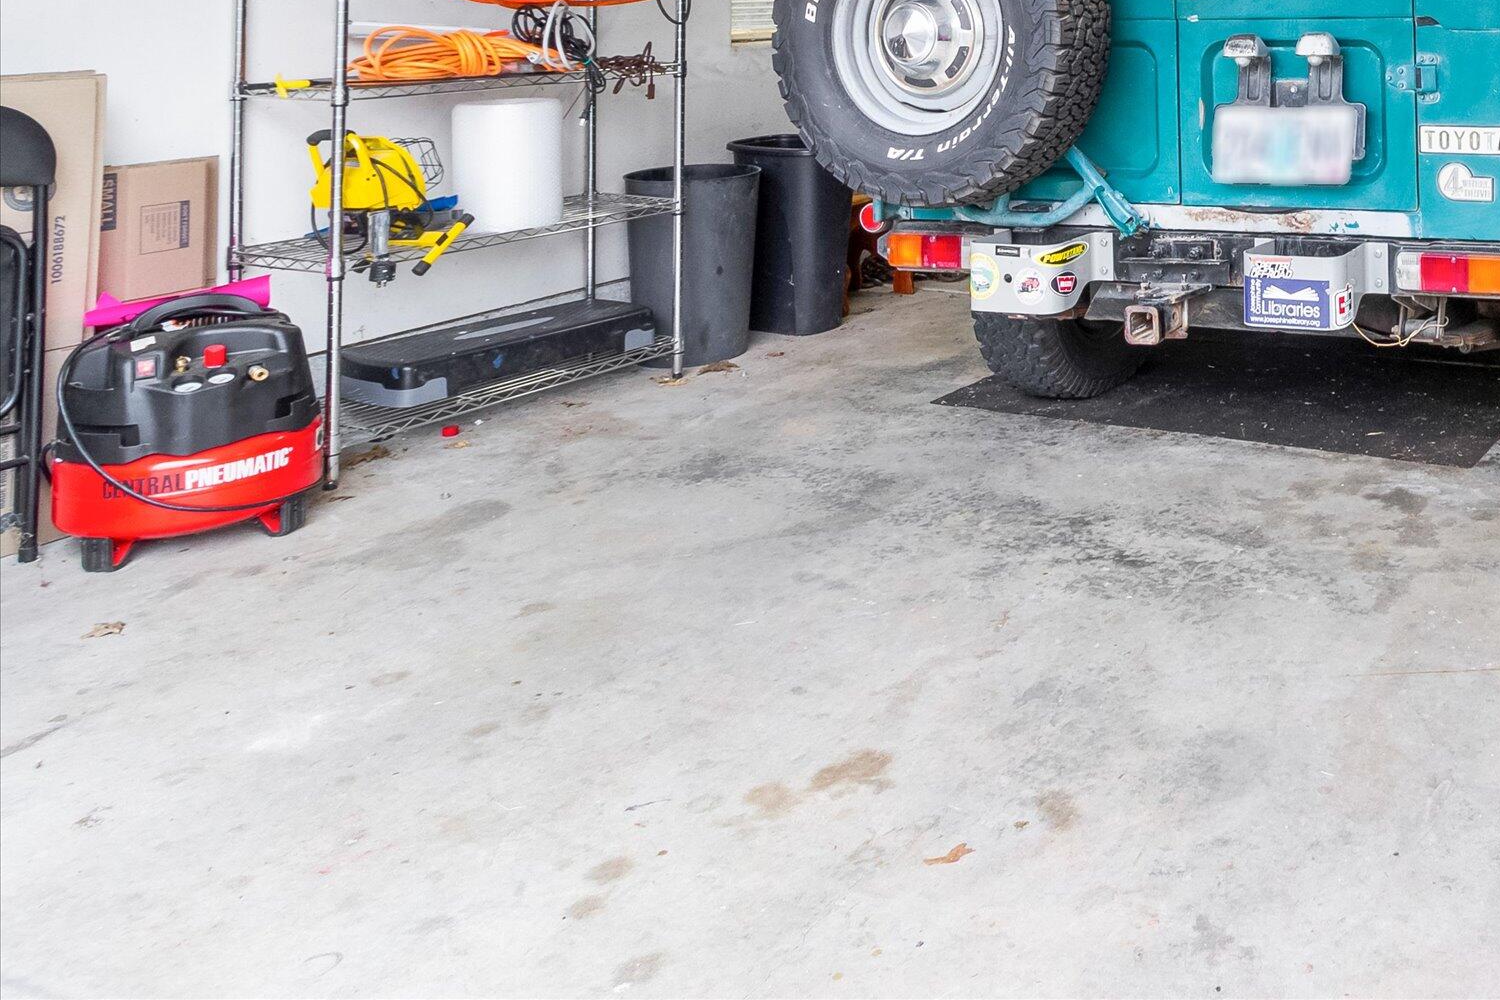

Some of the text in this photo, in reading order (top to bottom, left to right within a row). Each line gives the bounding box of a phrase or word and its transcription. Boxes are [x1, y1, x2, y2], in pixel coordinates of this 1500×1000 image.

[887, 25, 1016, 161] All-Terrain T/A
[1261, 300, 1321, 318] Libraries
[184, 448, 290, 490] PNEUMATIC
